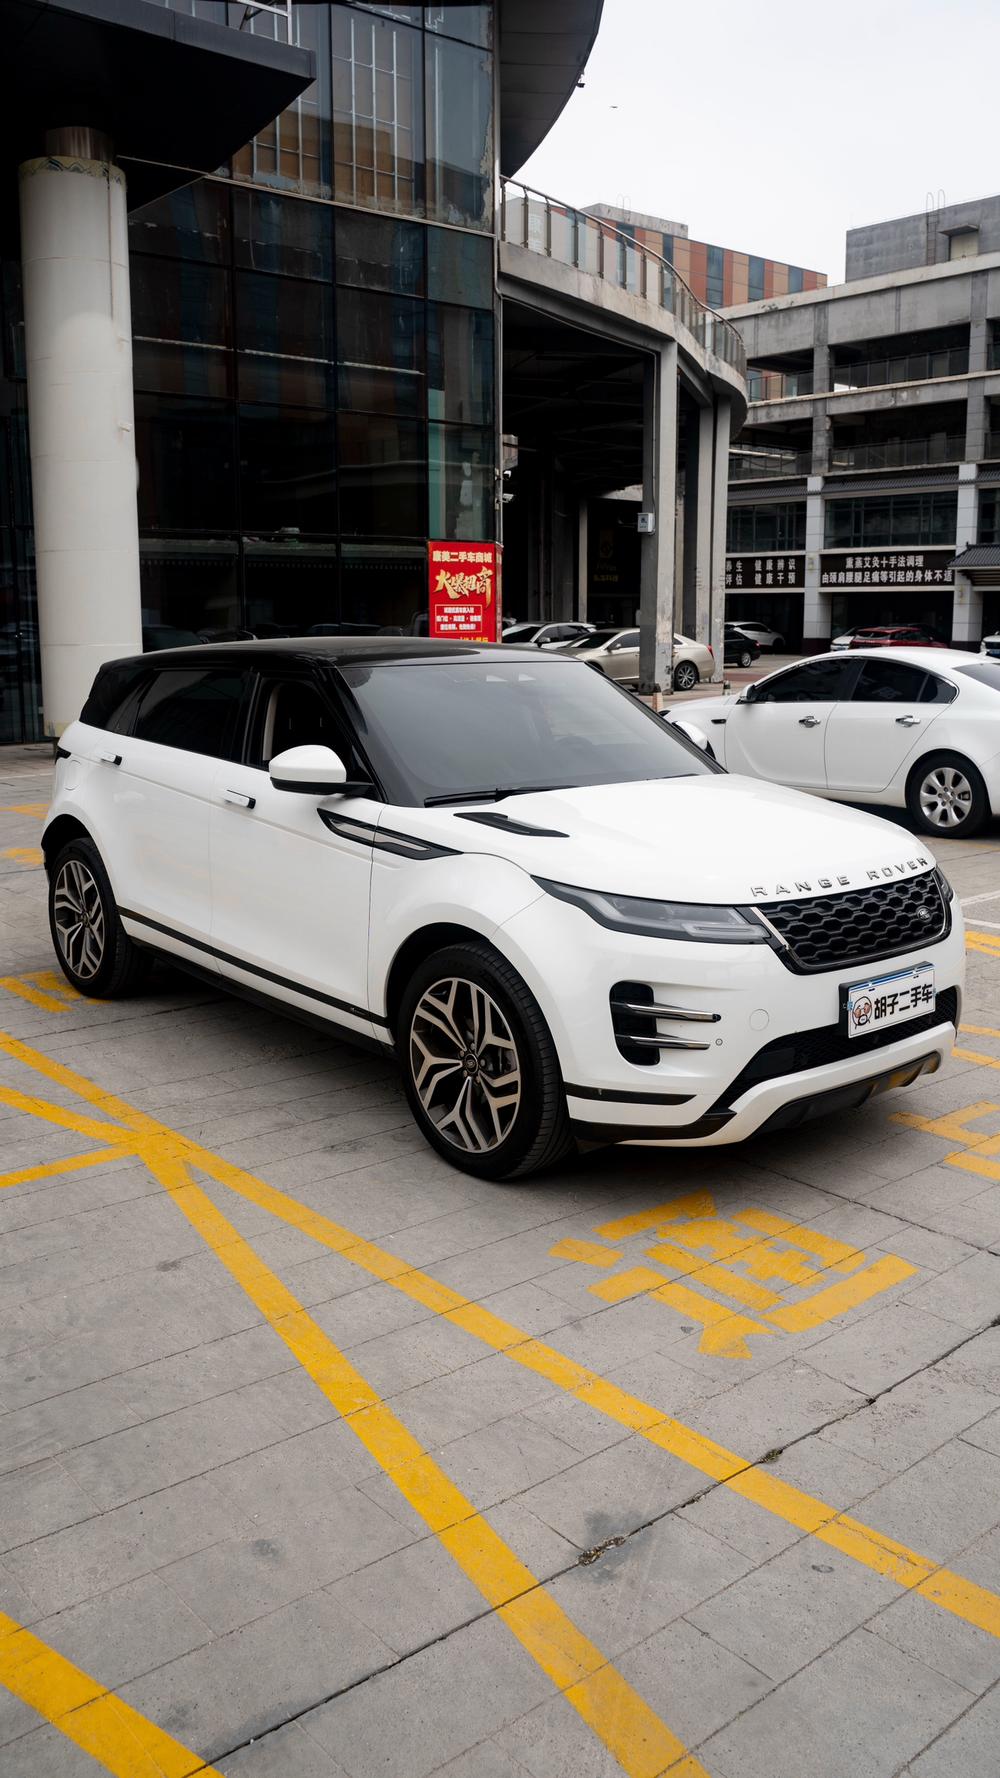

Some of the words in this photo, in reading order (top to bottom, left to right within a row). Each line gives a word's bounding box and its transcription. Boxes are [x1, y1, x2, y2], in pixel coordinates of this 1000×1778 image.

[750, 876, 851, 898] RANGE
[866, 857, 929, 881] ROVER
[873, 983, 933, 1020] 胡子二手车
